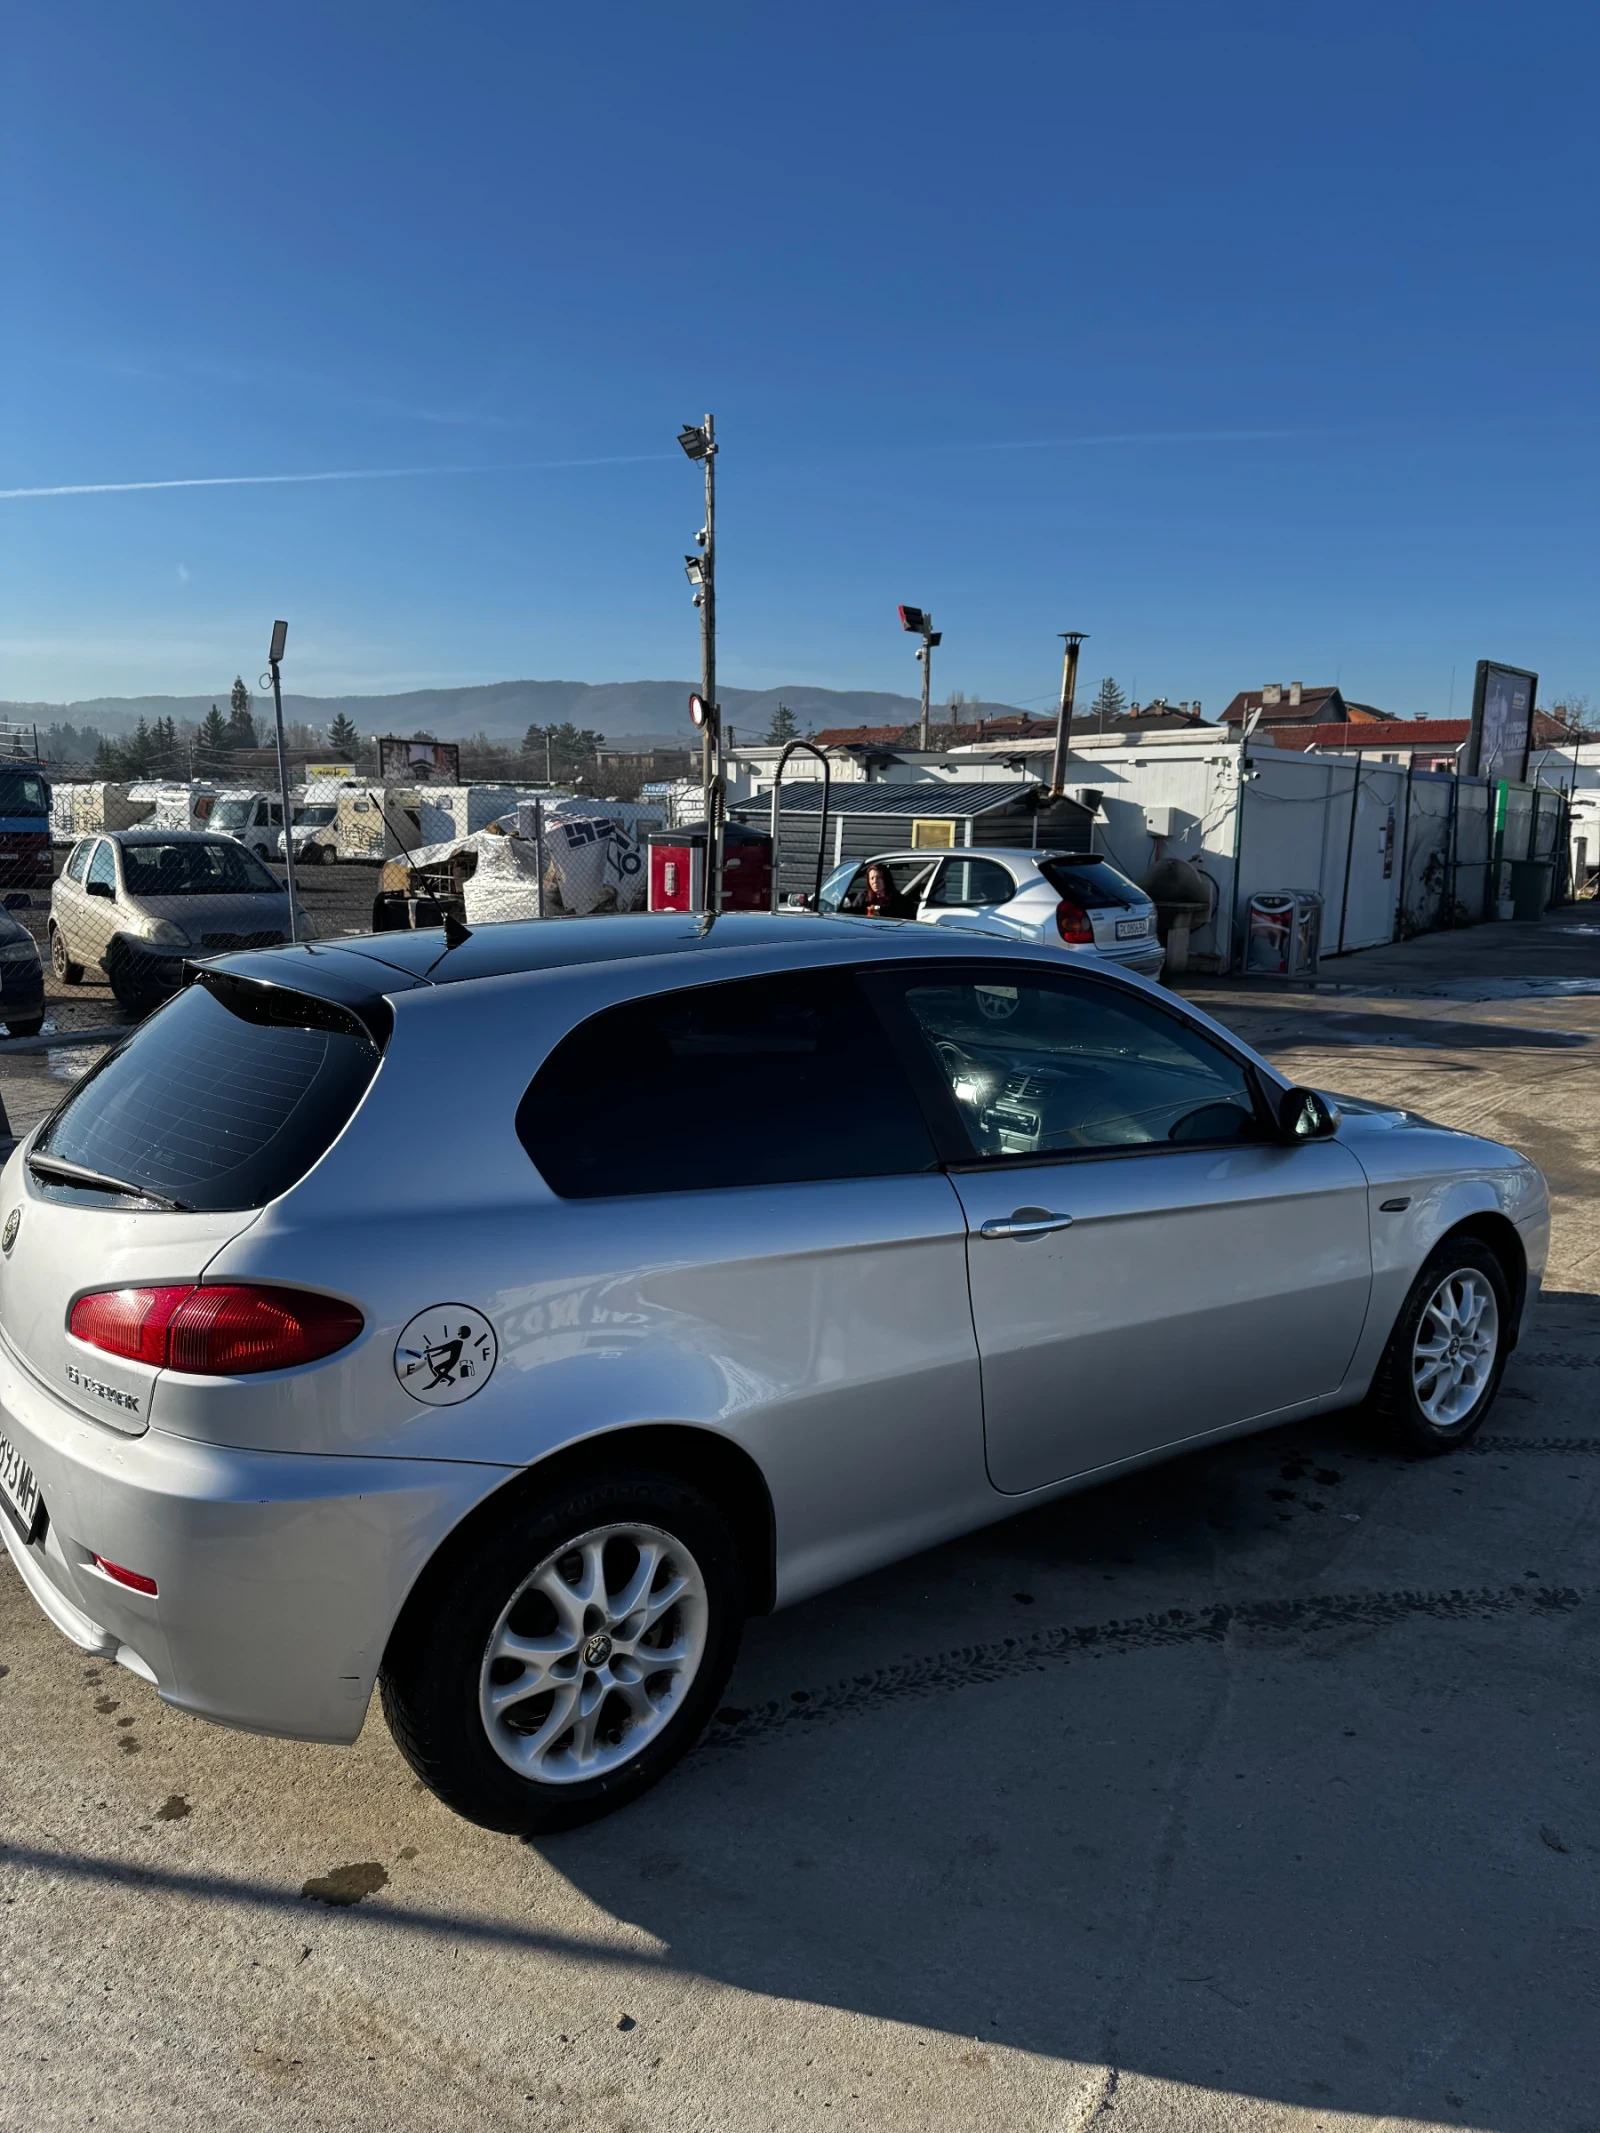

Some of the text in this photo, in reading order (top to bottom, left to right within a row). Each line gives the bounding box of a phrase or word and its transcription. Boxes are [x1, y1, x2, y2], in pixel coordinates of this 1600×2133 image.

[406, 1347, 491, 1376] E F
[0, 1431, 38, 1520] 893MH
